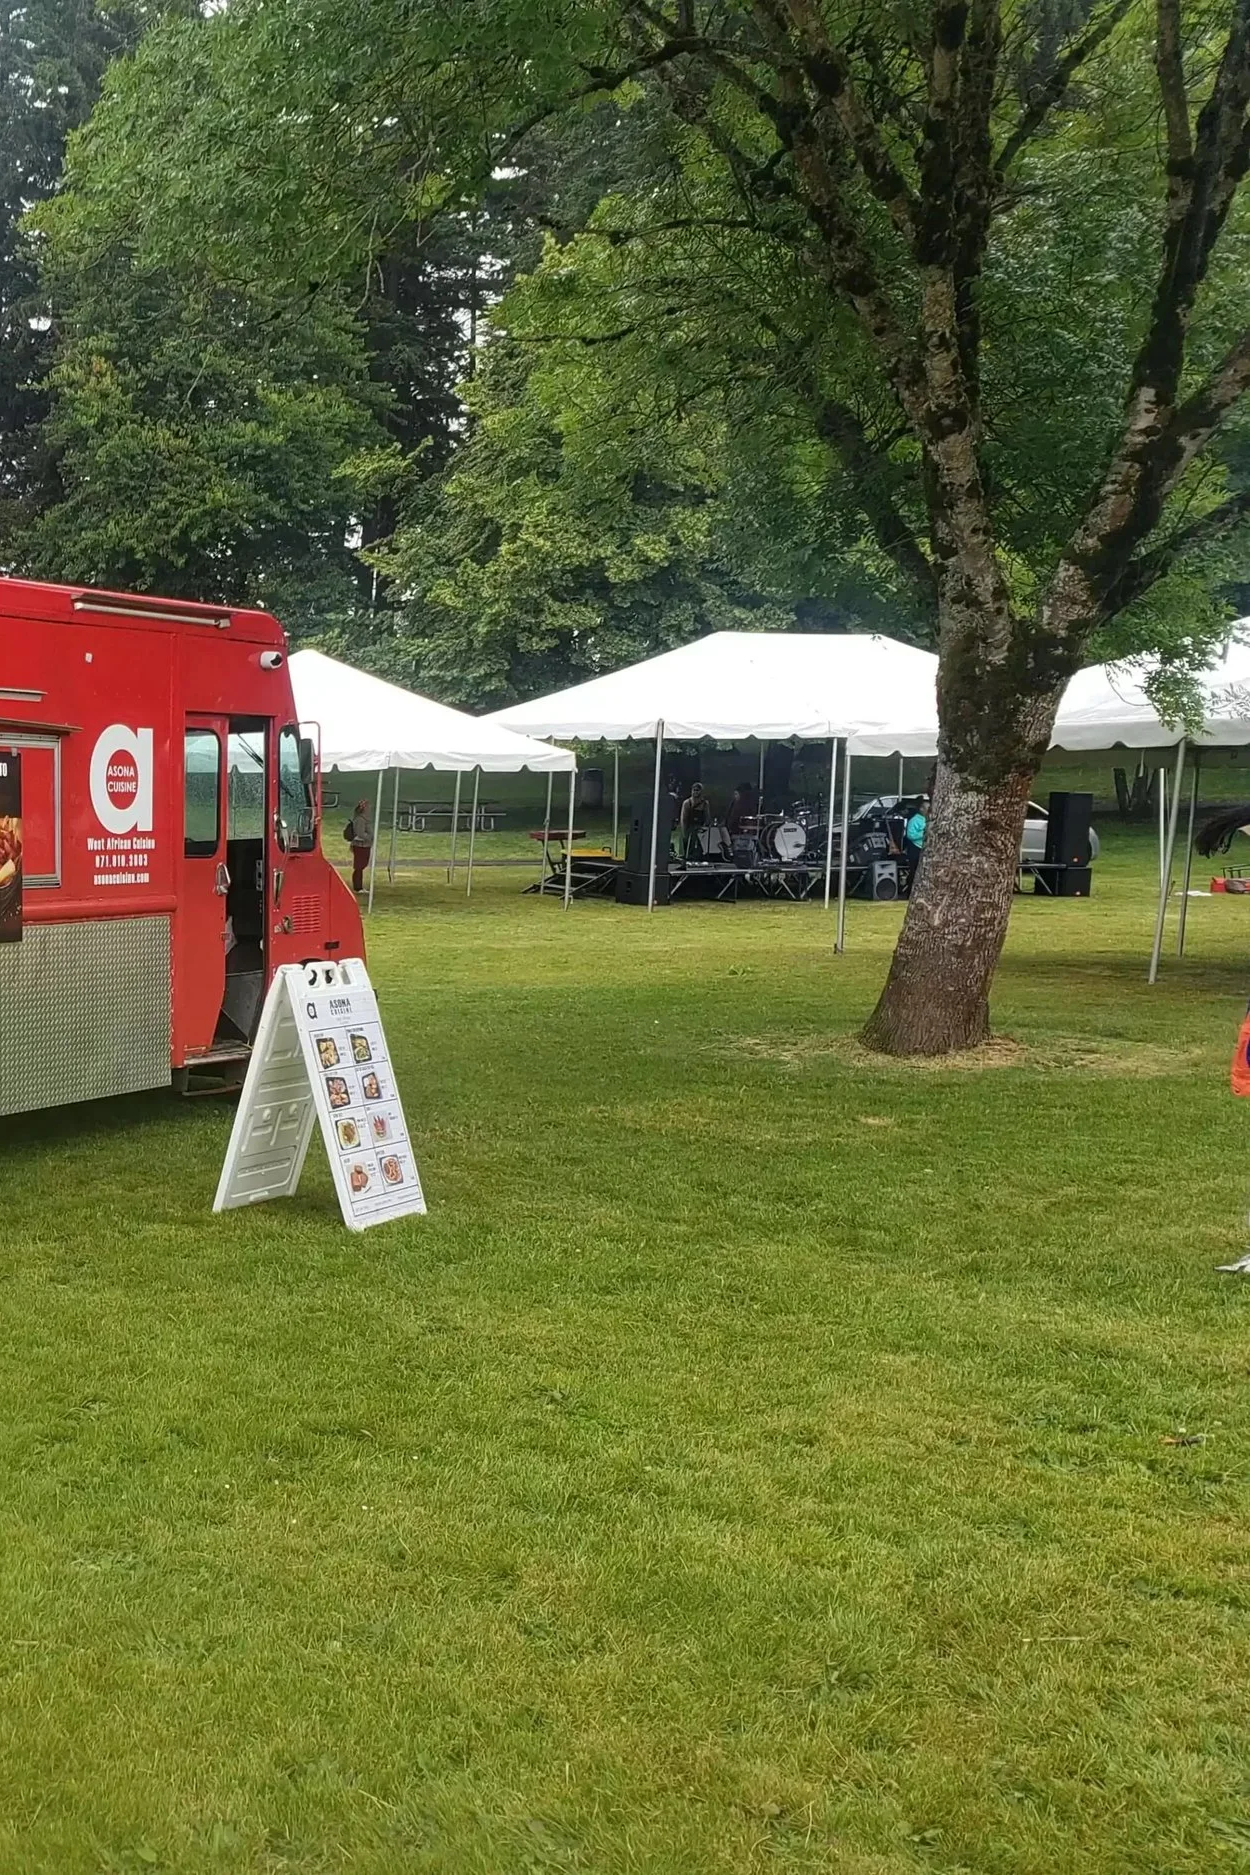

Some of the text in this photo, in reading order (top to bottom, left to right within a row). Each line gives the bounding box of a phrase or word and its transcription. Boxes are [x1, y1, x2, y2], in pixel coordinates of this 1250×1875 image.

[107, 765, 135, 777] ASONA
[107, 781, 137, 793] CUISINE
[87, 836, 156, 851] West African Cuisine
[329, 998, 351, 1010] ASONA
